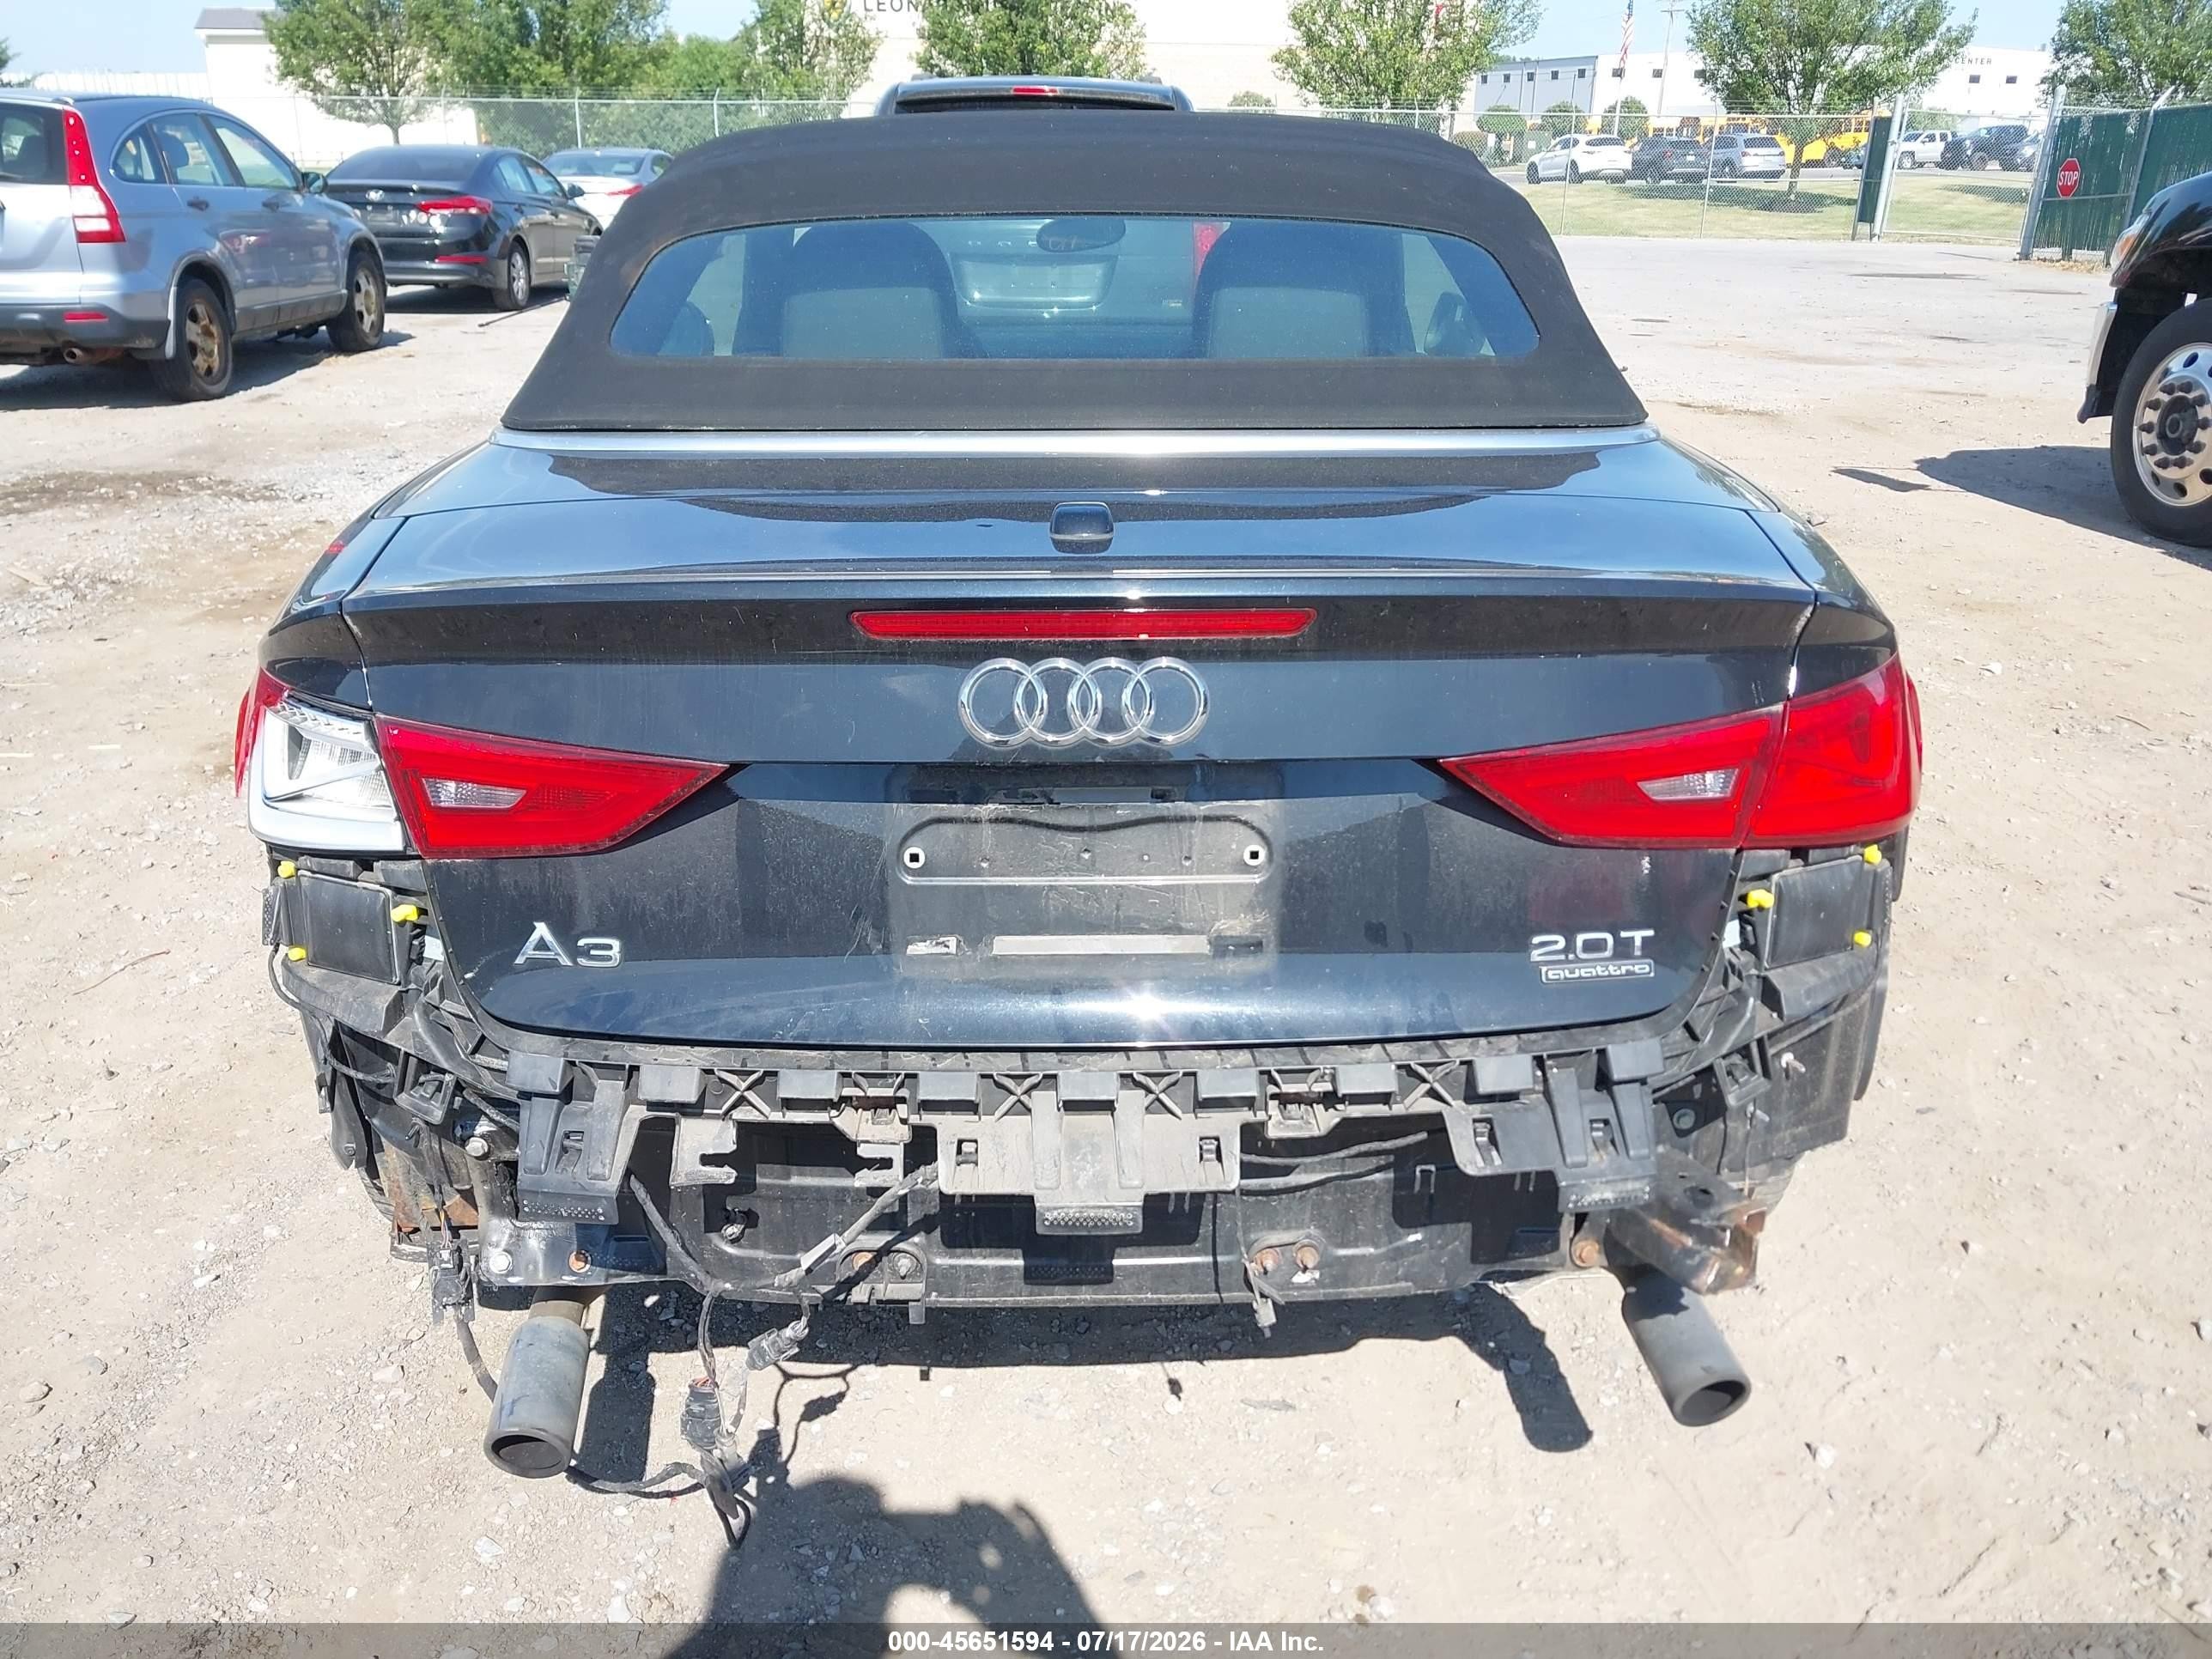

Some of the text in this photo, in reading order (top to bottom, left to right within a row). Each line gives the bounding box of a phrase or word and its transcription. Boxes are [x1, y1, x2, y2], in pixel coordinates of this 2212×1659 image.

[863, 0, 927, 12] LEON
[1954, 57, 1992, 66] CENTER
[2059, 171, 2078, 185] STOP
[514, 921, 621, 968] A3
[1547, 963, 1651, 981] quattro
